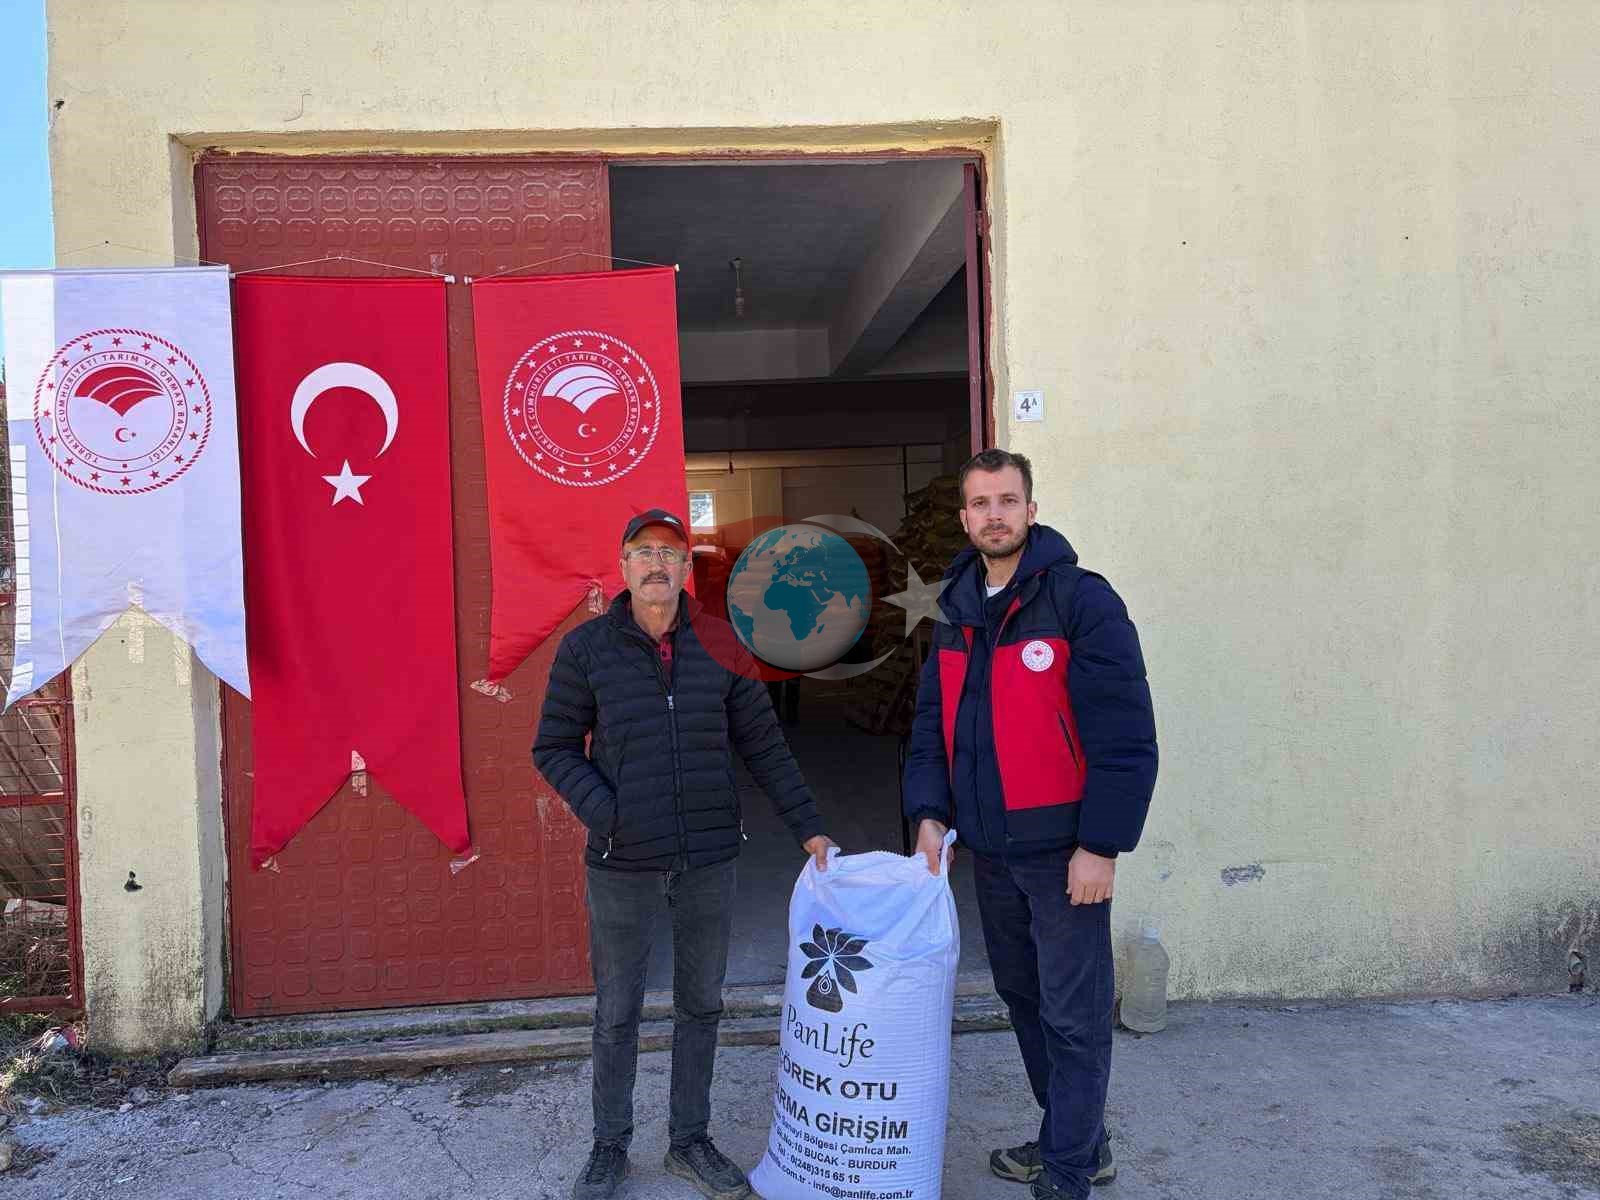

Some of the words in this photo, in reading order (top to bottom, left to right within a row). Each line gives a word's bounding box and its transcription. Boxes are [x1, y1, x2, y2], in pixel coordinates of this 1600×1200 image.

[102, 354, 139, 362] TARIM
[144, 359, 157, 370] VE
[160, 370, 184, 406] ORMAN
[601, 358, 613, 369] VE
[615, 369, 637, 403] ORMAN
[786, 1003, 875, 1069] PanLife
[840, 1080, 898, 1101] OTU
[815, 1112, 909, 1144] GİRİŞİM
[803, 1131, 838, 1152] Bölgesi
[840, 1143, 883, 1155] Çamlıca
[886, 1145, 912, 1155] Mah.
[804, 1147, 839, 1167] BUCAK
[848, 1160, 897, 1170] BURDUR
[832, 1171, 845, 1182] 65
[848, 1174, 860, 1184] 15
